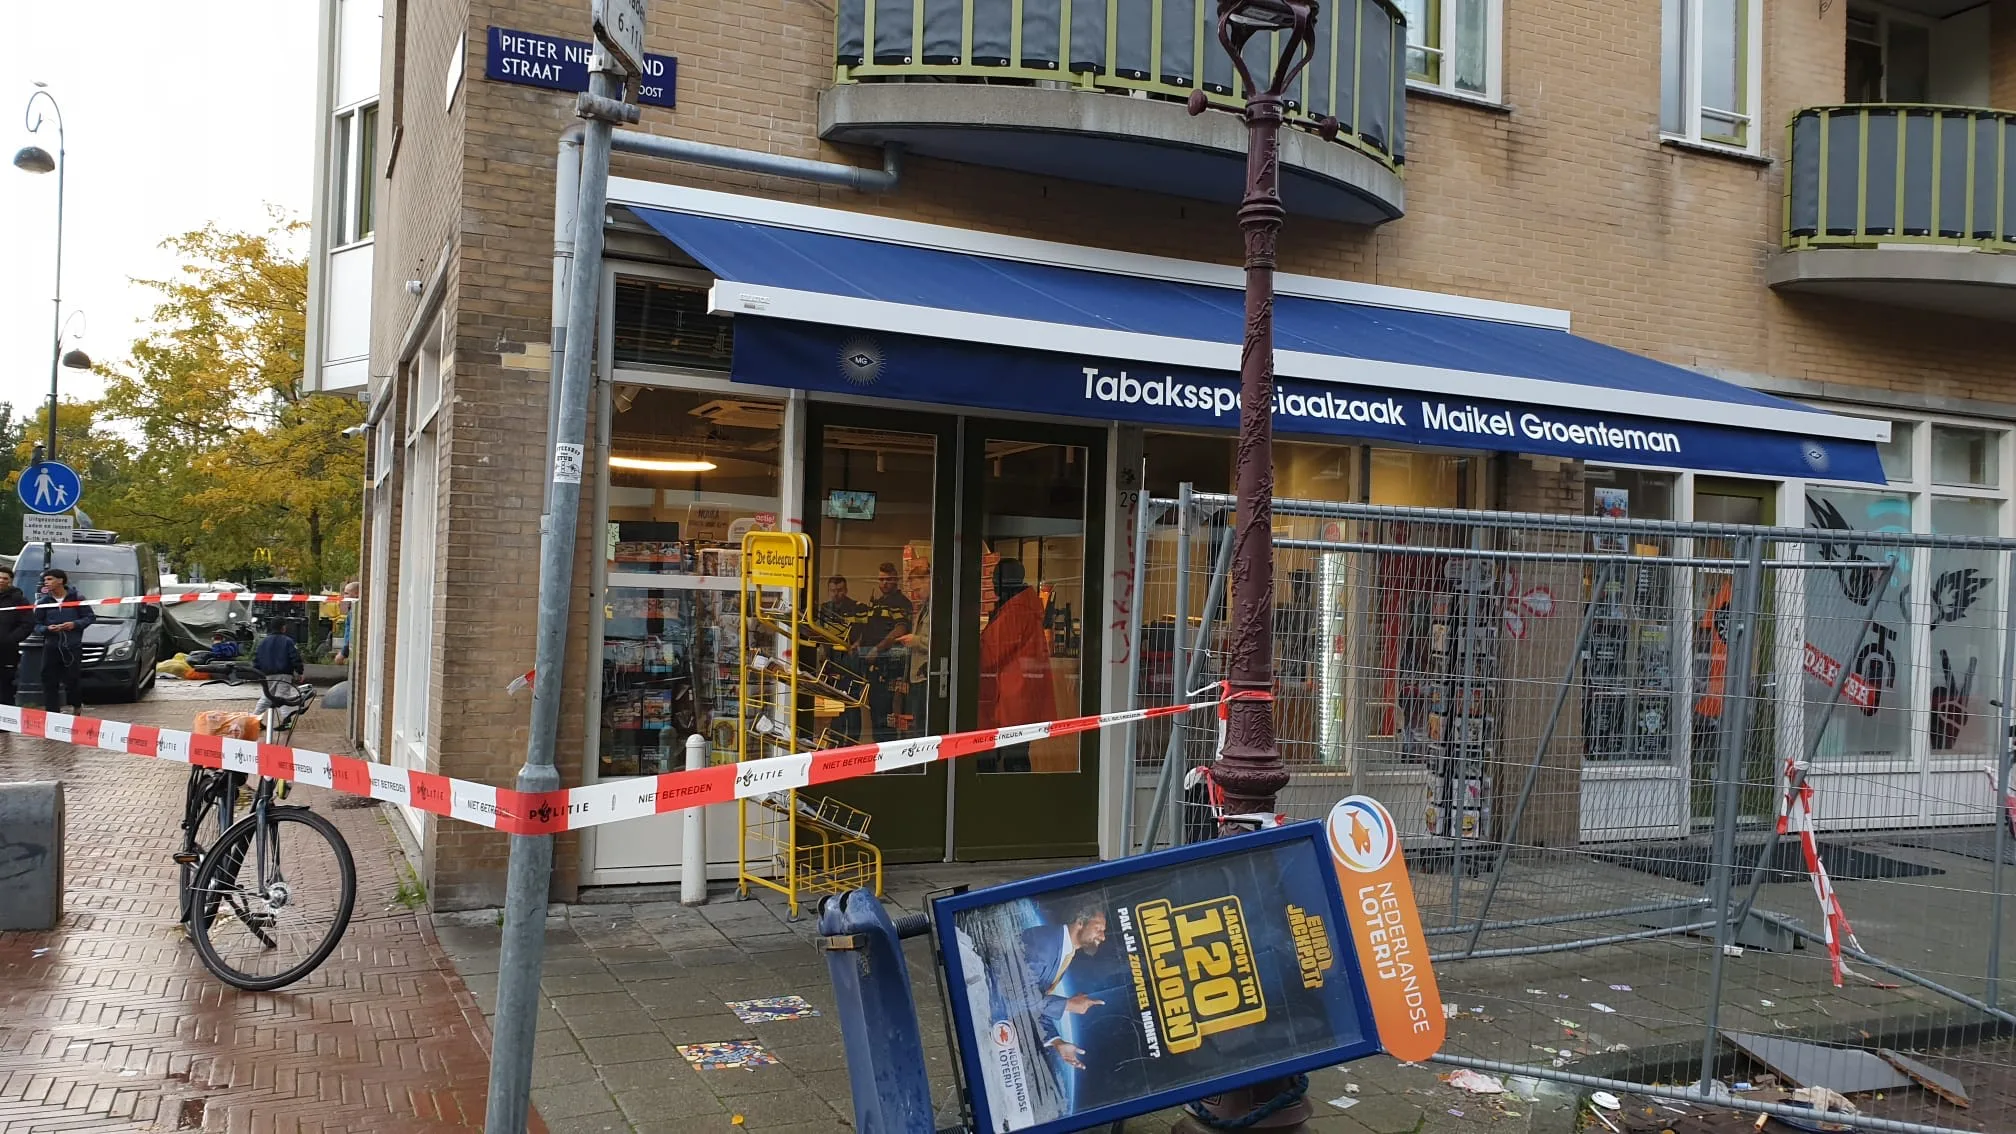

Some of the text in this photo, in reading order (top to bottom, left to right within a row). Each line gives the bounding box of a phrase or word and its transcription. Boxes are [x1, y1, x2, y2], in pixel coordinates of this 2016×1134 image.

[502, 35, 664, 77] PIETER NIEND
[502, 57, 563, 82] STRAAT
[1082, 367, 1682, 454] Tabaksspiaalzaak Maikel Groenteman
[1120, 491, 1138, 507] 29
[756, 550, 766, 565] De
[736, 768, 784, 787] POLITIE
[822, 753, 884, 771] NIET BETREDEN
[381, 780, 406, 793] BETREDEN
[417, 781, 444, 800] POLITIE
[638, 783, 713, 804] NIET BETREDEN
[467, 800, 479, 811] NIET
[529, 801, 589, 823] POLITIE
[1117, 907, 1132, 934] PAK
[1358, 886, 1397, 980] LOTERIJ
[1124, 933, 1137, 953] JIJ
[1287, 904, 1321, 981] JACKPOT
[1305, 915, 1331, 960] EURO
[1175, 908, 1240, 1017] 120
[1223, 905, 1258, 1005] JACKPOT TOT
[1377, 882, 1430, 1034] NEDERLANDSE
[1141, 906, 1195, 1038] MILJOEN
[1141, 1010, 1161, 1058] MONEY?
[999, 1049, 1014, 1088] LOTERIJ
[1008, 1047, 1027, 1113] NEDERLANDSE
